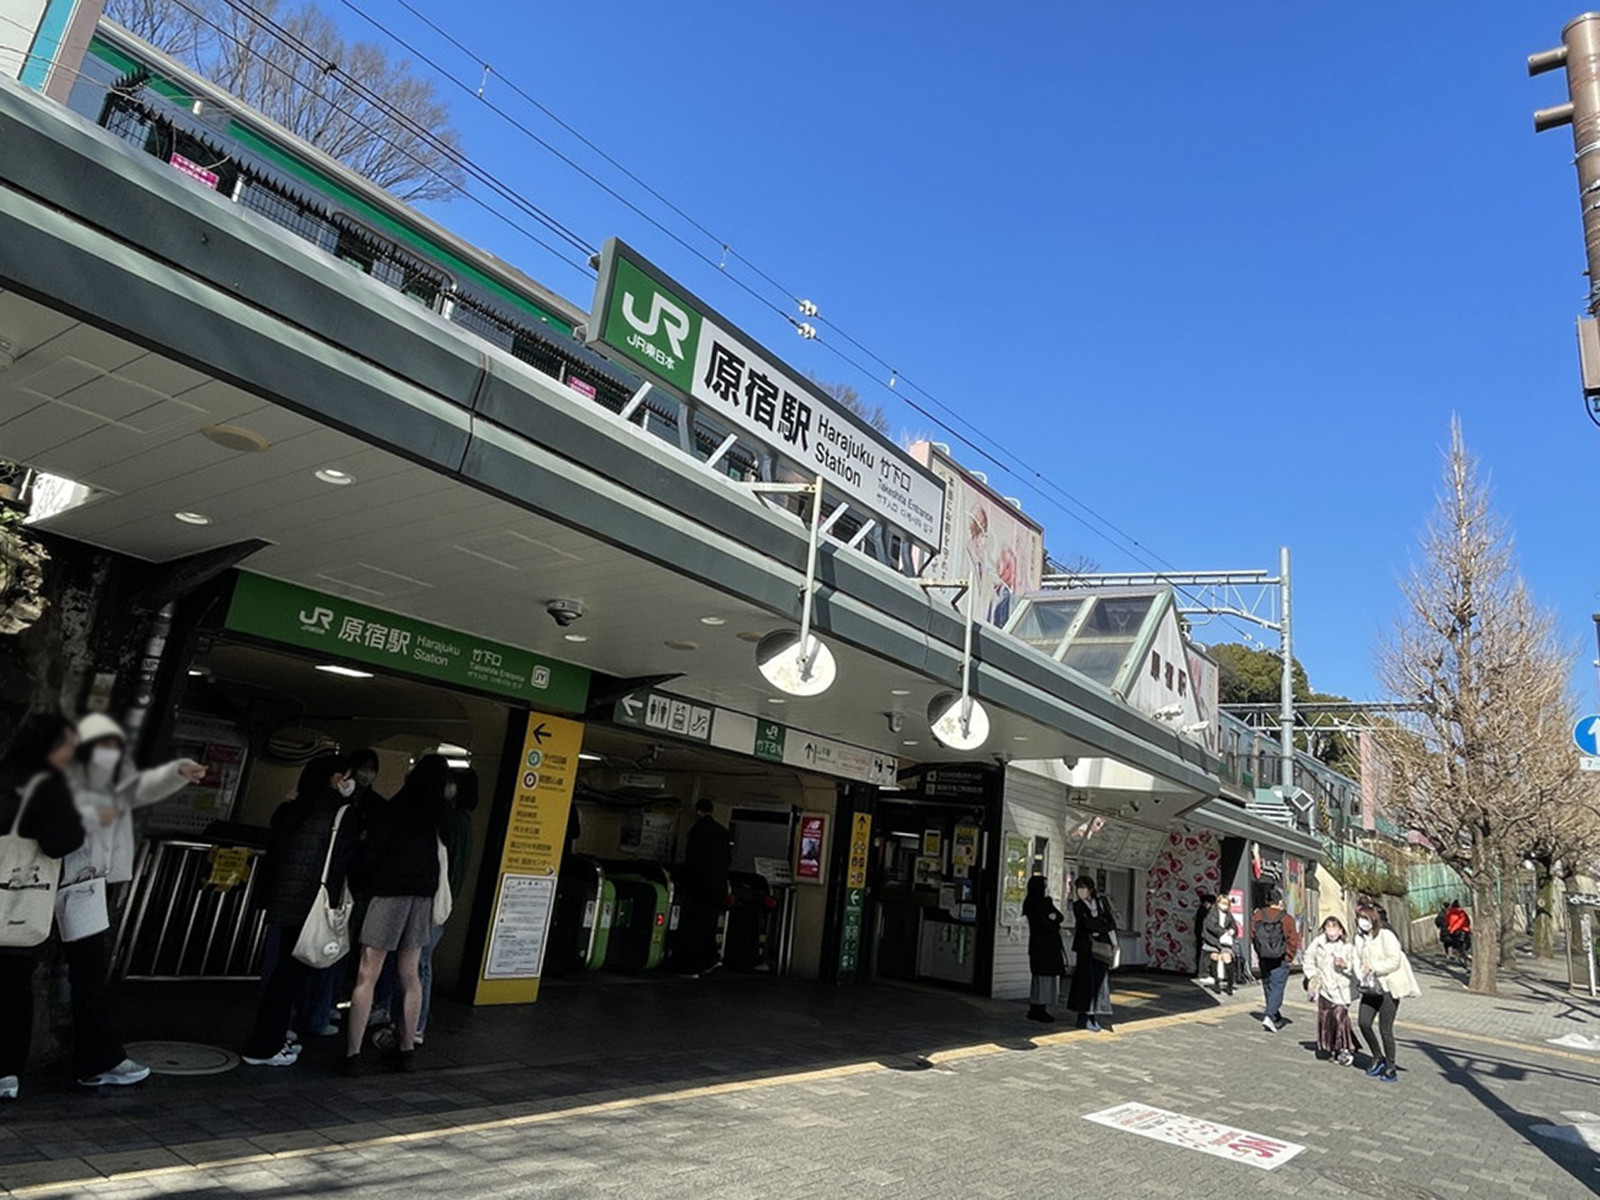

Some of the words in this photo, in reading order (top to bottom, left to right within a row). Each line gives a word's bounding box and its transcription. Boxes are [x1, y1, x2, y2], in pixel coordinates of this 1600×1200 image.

[621, 291, 690, 361] JR
[626, 334, 676, 371] JR東日本
[704, 341, 812, 452] 原宿駅
[818, 414, 875, 469] Harajuku
[815, 445, 861, 488] Station
[880, 457, 911, 493] 竹下口
[907, 494, 934, 522] Entrance
[299, 606, 334, 631] JR
[338, 616, 411, 655] 原宿駅
[413, 647, 448, 666] Station
[416, 635, 460, 656] Harajuku
[471, 647, 502, 666] 竹下口
[766, 725, 779, 737] JR
